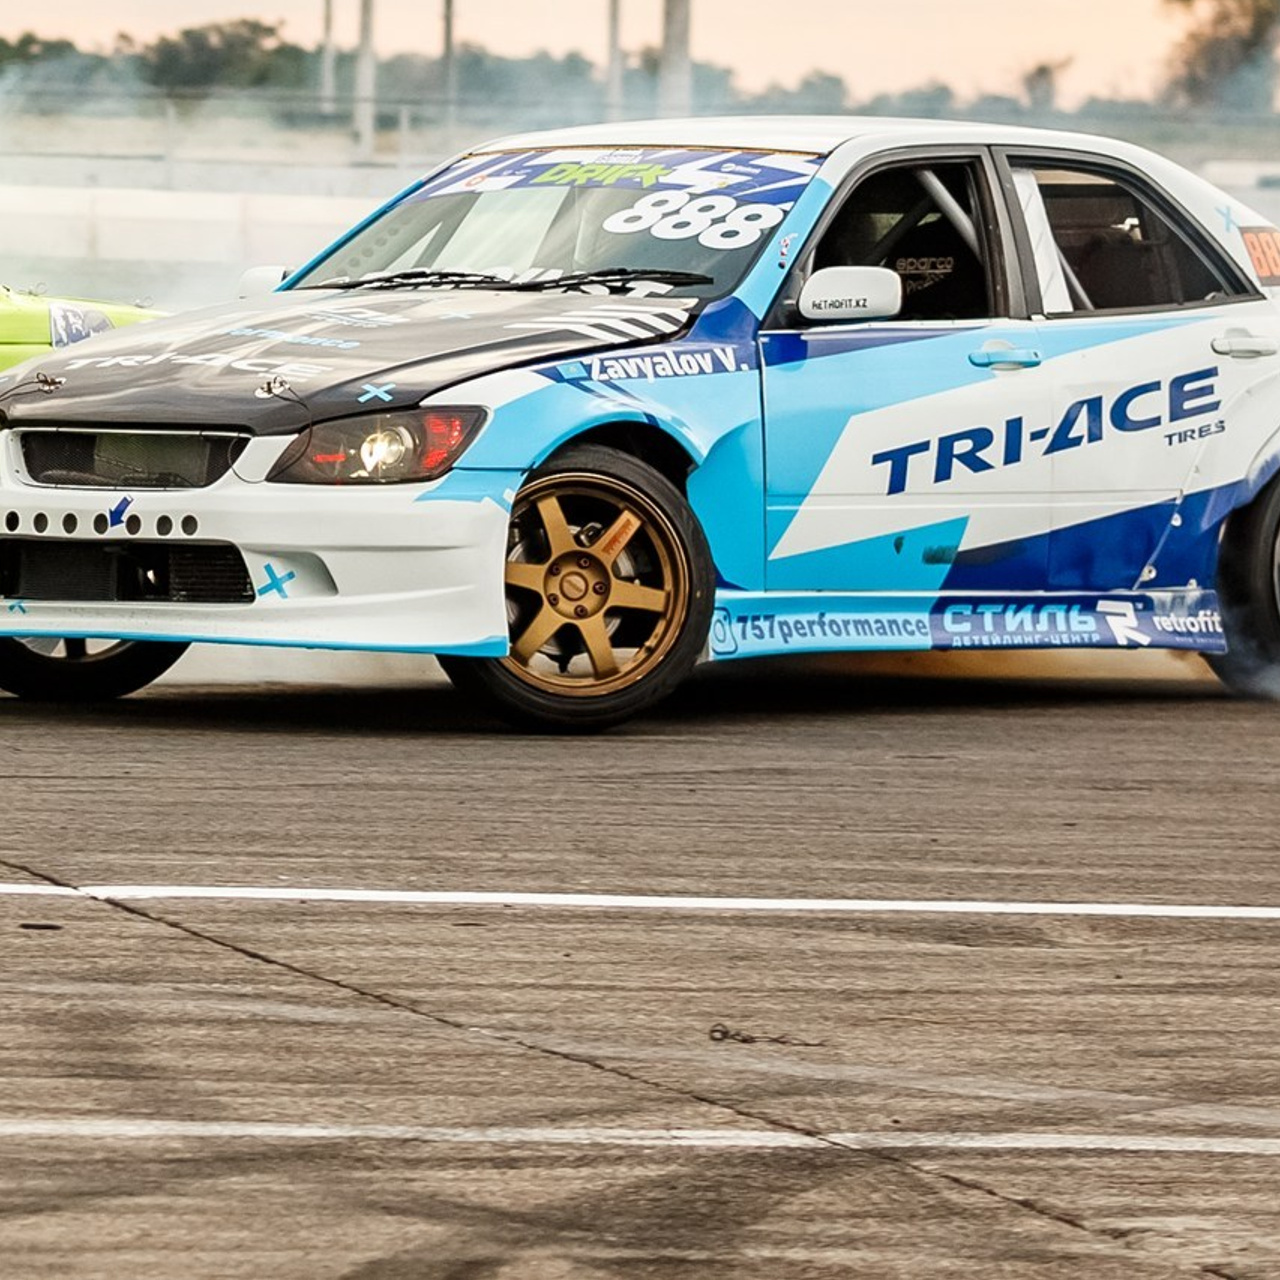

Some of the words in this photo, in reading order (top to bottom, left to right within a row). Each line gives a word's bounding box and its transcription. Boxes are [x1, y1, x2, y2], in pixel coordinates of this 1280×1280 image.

[530, 163, 673, 187] DRIFT
[602, 190, 784, 249] 888
[895, 256, 954, 272] sparco
[1243, 232, 1280, 278] 88
[589, 350, 711, 384] Zavyalov
[714, 348, 750, 372] V.
[871, 366, 1222, 497] TRI-ACE
[1164, 420, 1226, 447] TIRES
[735, 610, 929, 650] 757performance
[942, 603, 1098, 634] СТИЛЬ
[1152, 609, 1224, 635] retrofit
[951, 632, 1102, 648] ДЕТЕЙЛИНГ-ЦЕНТР
